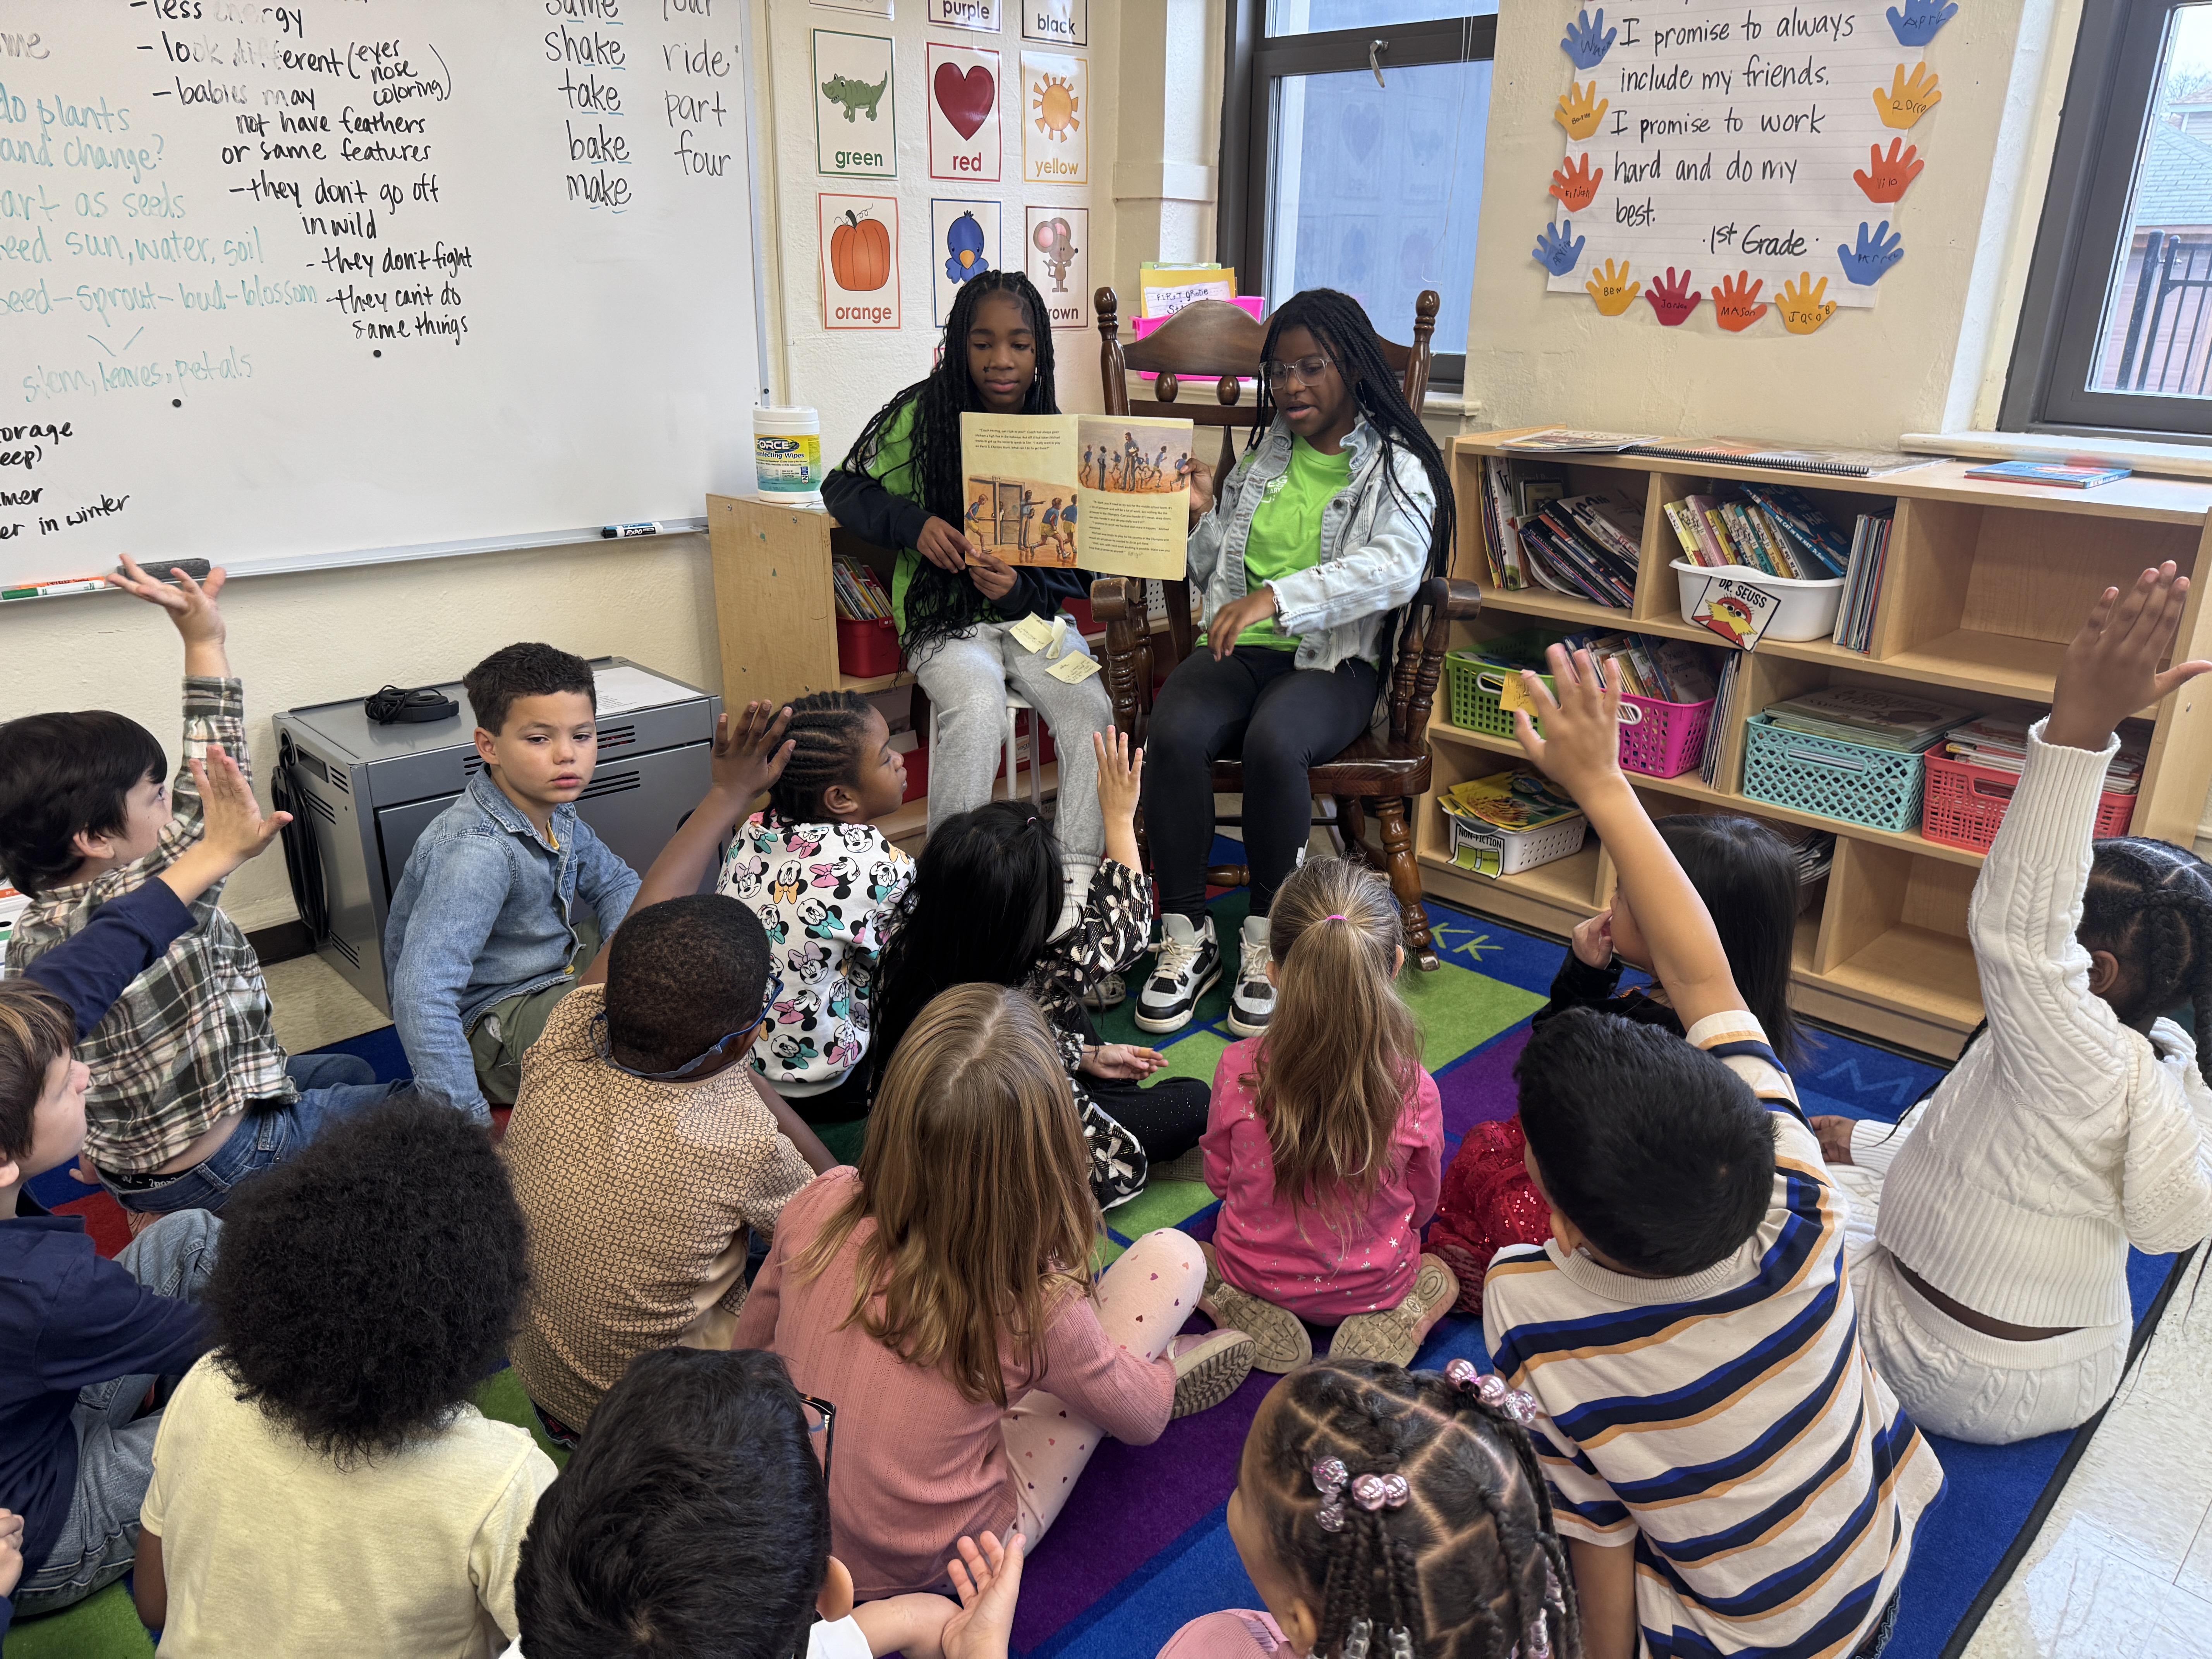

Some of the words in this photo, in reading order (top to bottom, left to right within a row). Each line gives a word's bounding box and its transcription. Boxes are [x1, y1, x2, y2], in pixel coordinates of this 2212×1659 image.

[943, 0, 990, 20] purple
[1037, 14, 1076, 35] black
[545, 24, 625, 65] shake
[1620, 19, 1640, 45] I
[1655, 20, 1730, 56] promise
[1741, 10, 1761, 40] to
[1776, 7, 1854, 48] always
[234, 38, 344, 77] different
[371, 59, 418, 84] nose
[663, 39, 730, 77] ride
[1620, 64, 1692, 93] include
[1702, 67, 1731, 94] my
[1746, 54, 1830, 89] friends.
[262, 86, 316, 110] may
[558, 68, 621, 111] take
[37, 94, 130, 141] plants
[236, 112, 270, 137] not
[280, 110, 331, 133] have
[338, 106, 426, 135] feathers
[665, 90, 727, 128] part
[1610, 110, 1629, 136] I
[1640, 109, 1711, 143] promise
[1724, 107, 1743, 133] to
[1760, 102, 1827, 134] work
[222, 145, 251, 165] or
[261, 143, 327, 161] same
[341, 139, 432, 161] features
[566, 119, 629, 161] bake
[674, 129, 731, 176] four
[0, 133, 53, 167] and
[64, 134, 165, 184] change?
[835, 150, 883, 169] green
[953, 153, 982, 172] red
[1035, 158, 1079, 177] yellow
[1614, 151, 1661, 183] hard
[1676, 154, 1711, 181] and
[1726, 151, 1752, 182] do
[1762, 158, 1798, 184] my
[76, 191, 110, 218] as
[123, 181, 186, 219] seeds
[315, 177, 368, 204] don't
[380, 183, 404, 215] go
[413, 173, 439, 203] off
[567, 169, 632, 206] make
[299, 212, 327, 235] in
[331, 209, 377, 239] wild
[1615, 196, 1656, 227] best.
[223, 226, 264, 267] soil
[1710, 222, 1738, 254] 1st
[382, 247, 429, 273] don't
[432, 241, 472, 278] fight
[395, 283, 434, 308] can't
[441, 280, 462, 306] do
[352, 319, 411, 339] same
[415, 311, 468, 346] things
[835, 306, 892, 324] orange
[1047, 307, 1079, 321] rown
[39, 517, 59, 535] in
[66, 494, 130, 527] winter
[1774, 514, 1783, 523] THE
[1781, 521, 1792, 531] CAT
[1795, 533, 1803, 541] THE
[1802, 539, 1812, 549] HAT
[1778, 538, 1786, 550] Zoo
[1719, 579, 1733, 593] DR.
[1735, 585, 1767, 608] SEUSS
[1459, 827, 1501, 849] NON-FICTION
